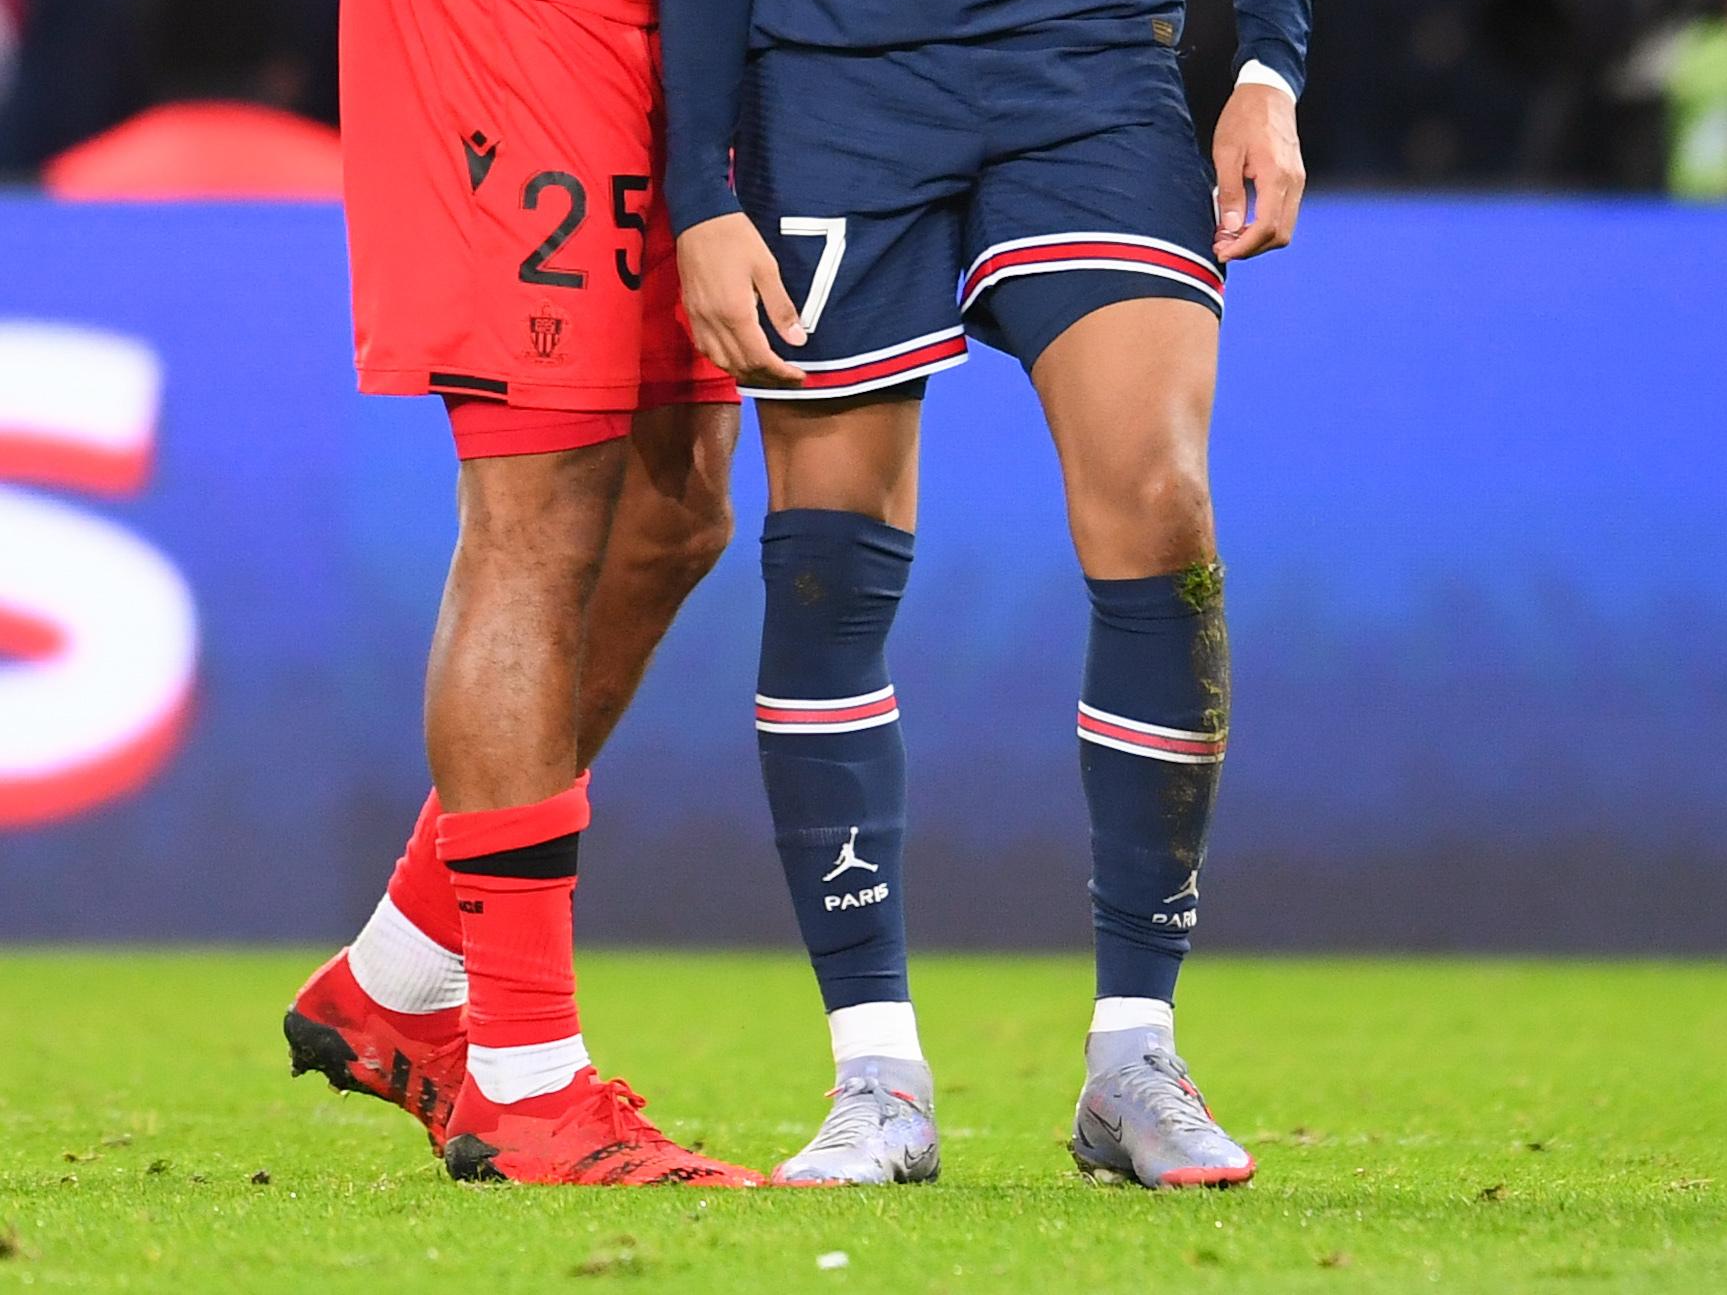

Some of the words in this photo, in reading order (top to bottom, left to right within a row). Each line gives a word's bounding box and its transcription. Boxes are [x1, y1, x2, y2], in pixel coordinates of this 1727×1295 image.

[518, 170, 650, 292] 25
[780, 216, 847, 334] 7
[824, 882, 889, 912] PARIS
